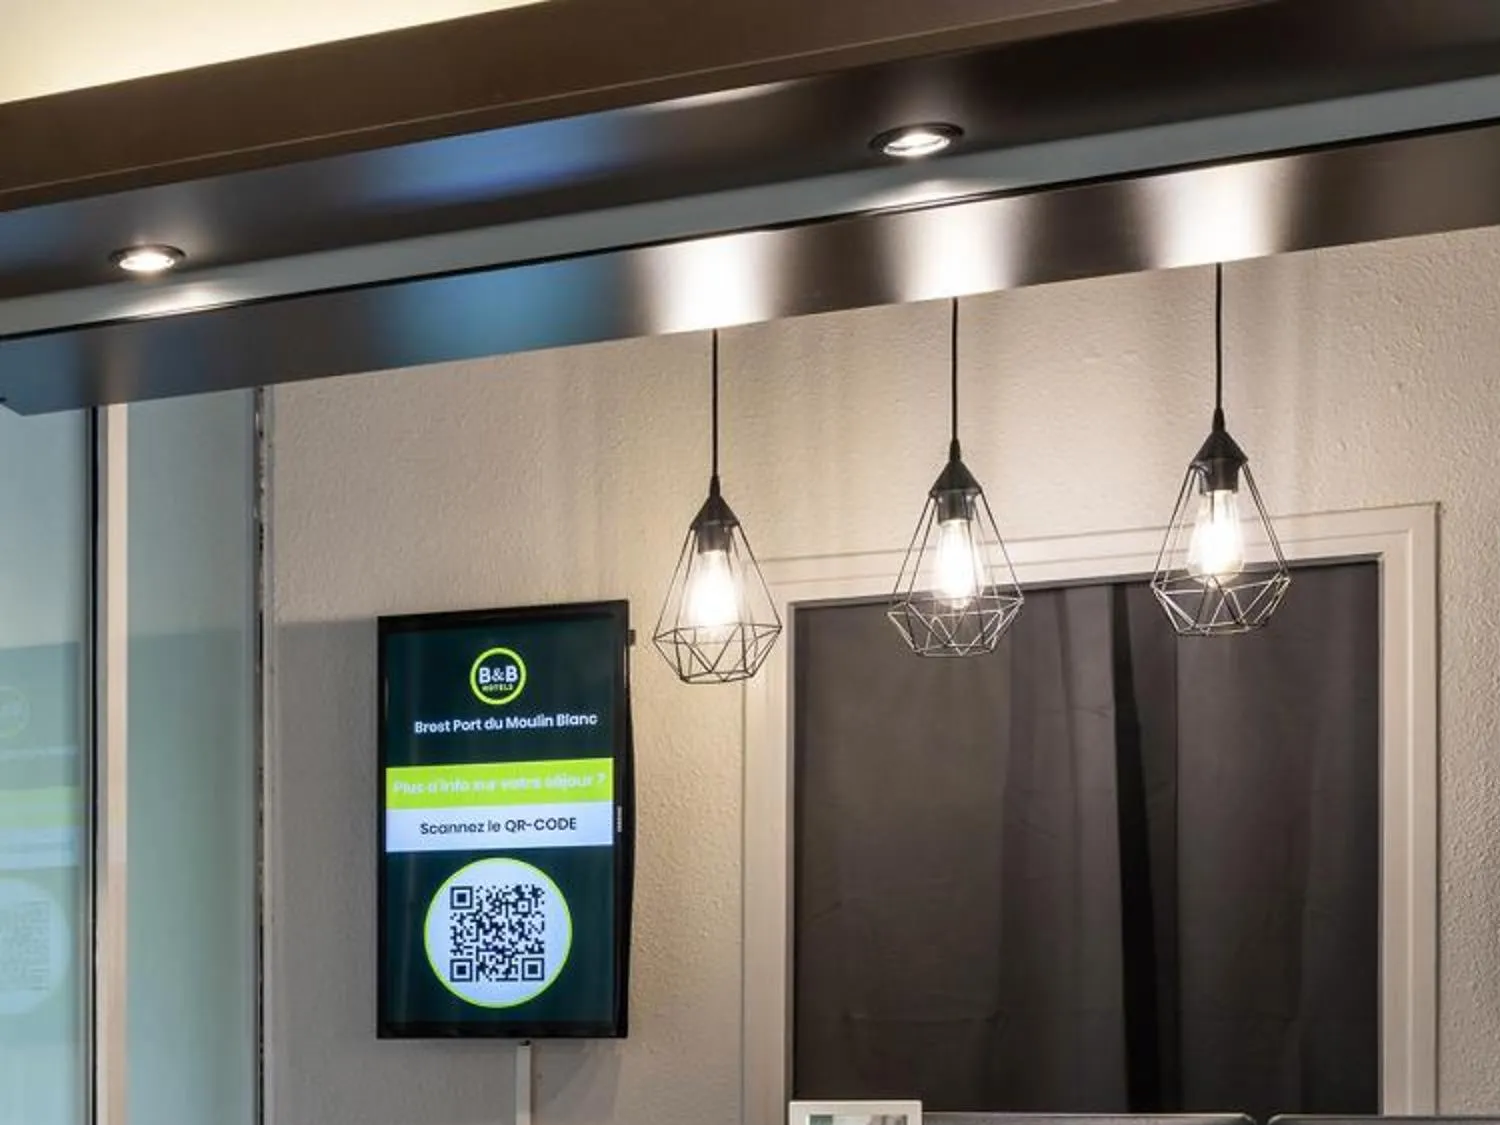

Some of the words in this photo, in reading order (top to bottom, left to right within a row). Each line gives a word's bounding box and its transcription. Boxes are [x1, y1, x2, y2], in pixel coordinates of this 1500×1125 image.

[478, 665, 518, 684] B&B
[482, 683, 513, 691] HOTELS
[414, 720, 451, 734] Brest
[452, 718, 482, 732] Port
[484, 717, 503, 730] du
[505, 714, 554, 729] Moulin
[556, 713, 598, 727] Blanc
[420, 821, 485, 835] Scannez
[488, 820, 501, 832] le
[505, 817, 577, 832] QR-CODE
